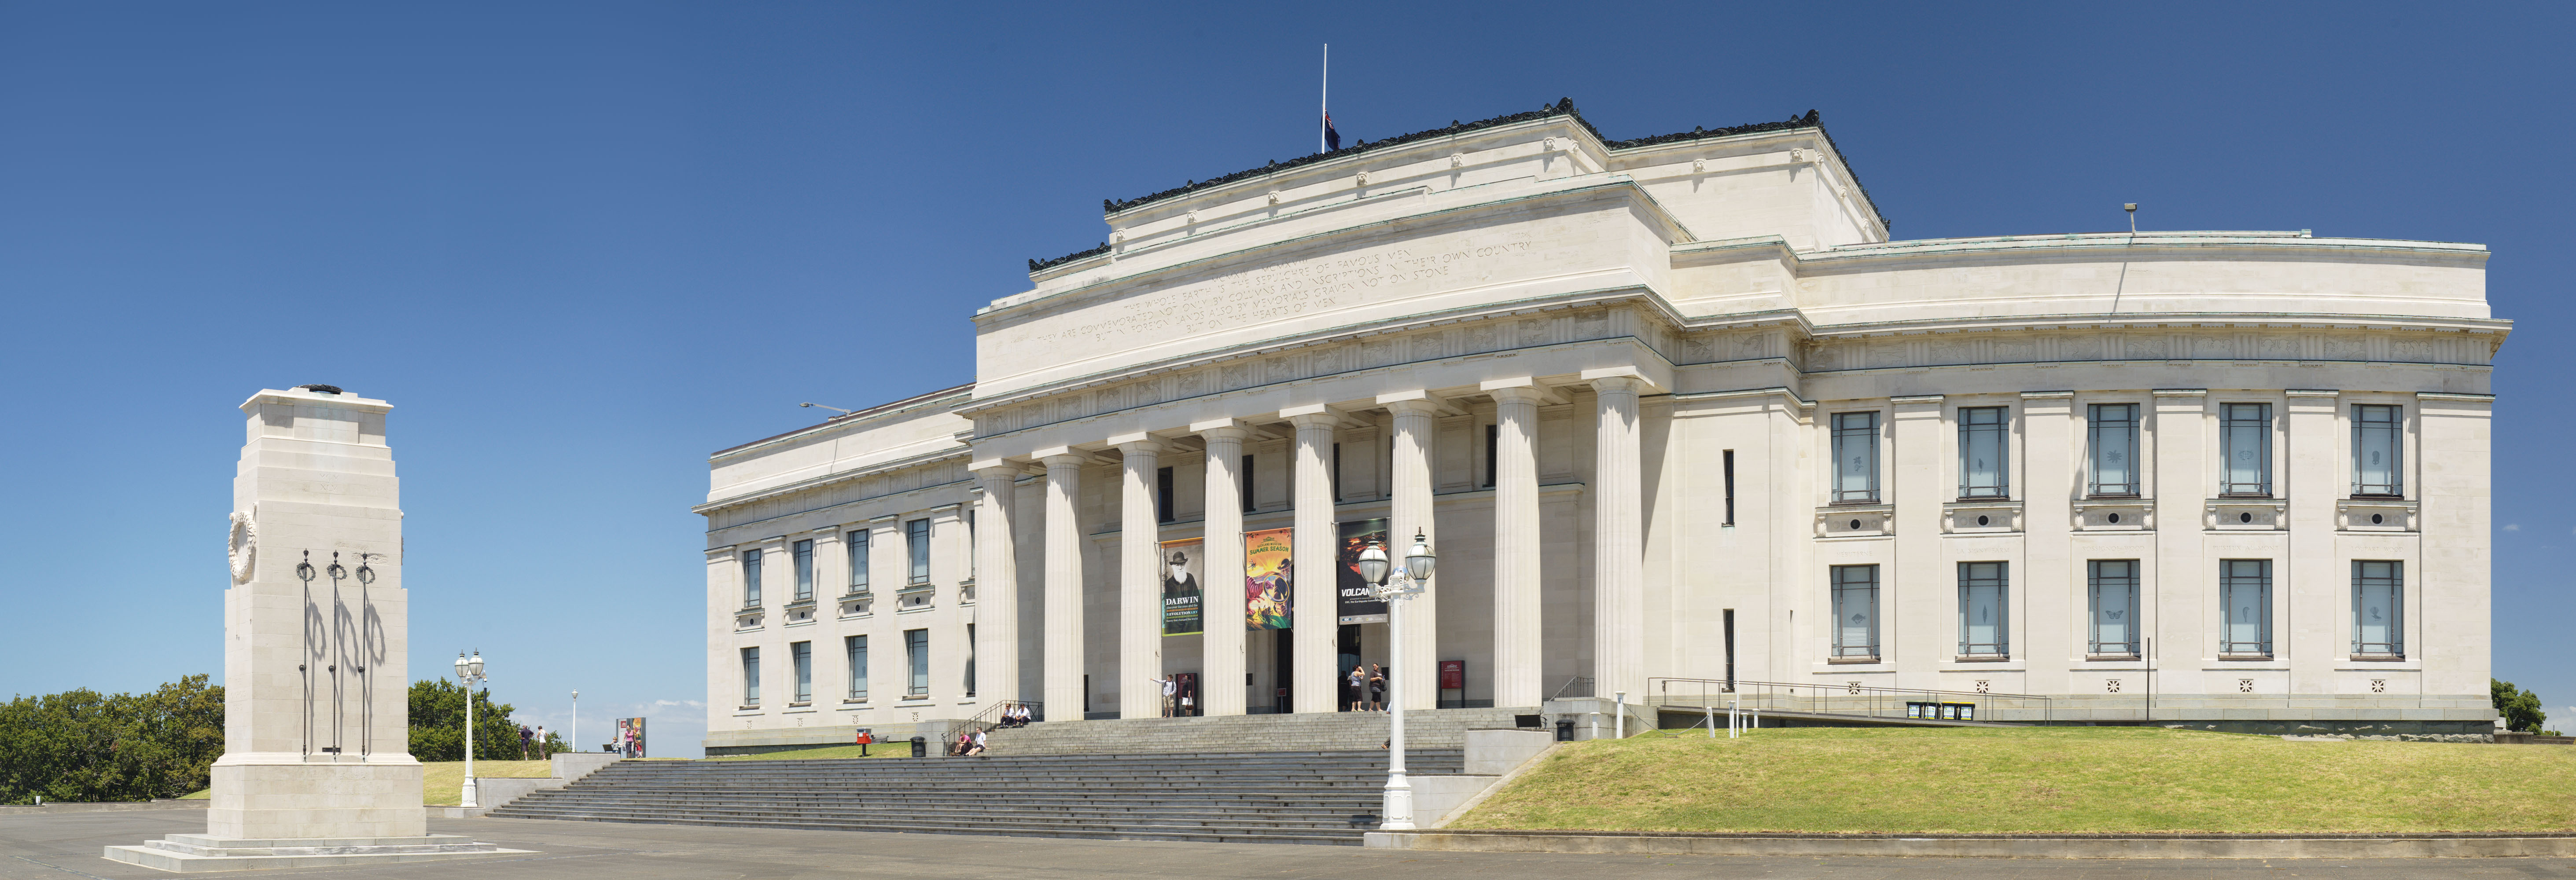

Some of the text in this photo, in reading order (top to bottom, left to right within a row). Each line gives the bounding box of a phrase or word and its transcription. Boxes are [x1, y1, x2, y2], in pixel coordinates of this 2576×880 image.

[1123, 248, 1411, 314] THE WHOLE EARTH IS THE SEPULCHRE OF FAMOUS MEN
[1211, 257, 1308, 283] MCMXIV MCMXVIII
[1037, 241, 1531, 345] THEY ARE COMMEMORATED NOT ONLY BY COLUMNS AND INSCRIPTIONS IN THEIR OWN COUNTRY
[1096, 266, 1448, 342] BUT IN FOREIGN LANDS ALSO BY MEMORIALS GRAVEN NOT ON STONE
[1186, 297, 1336, 333] BUT ON THE HEARTS OF MEN
[1250, 546, 1269, 555] SUMMER
[1166, 596, 1199, 605] DARWIN
[1341, 587, 1370, 597] VOLCAN
